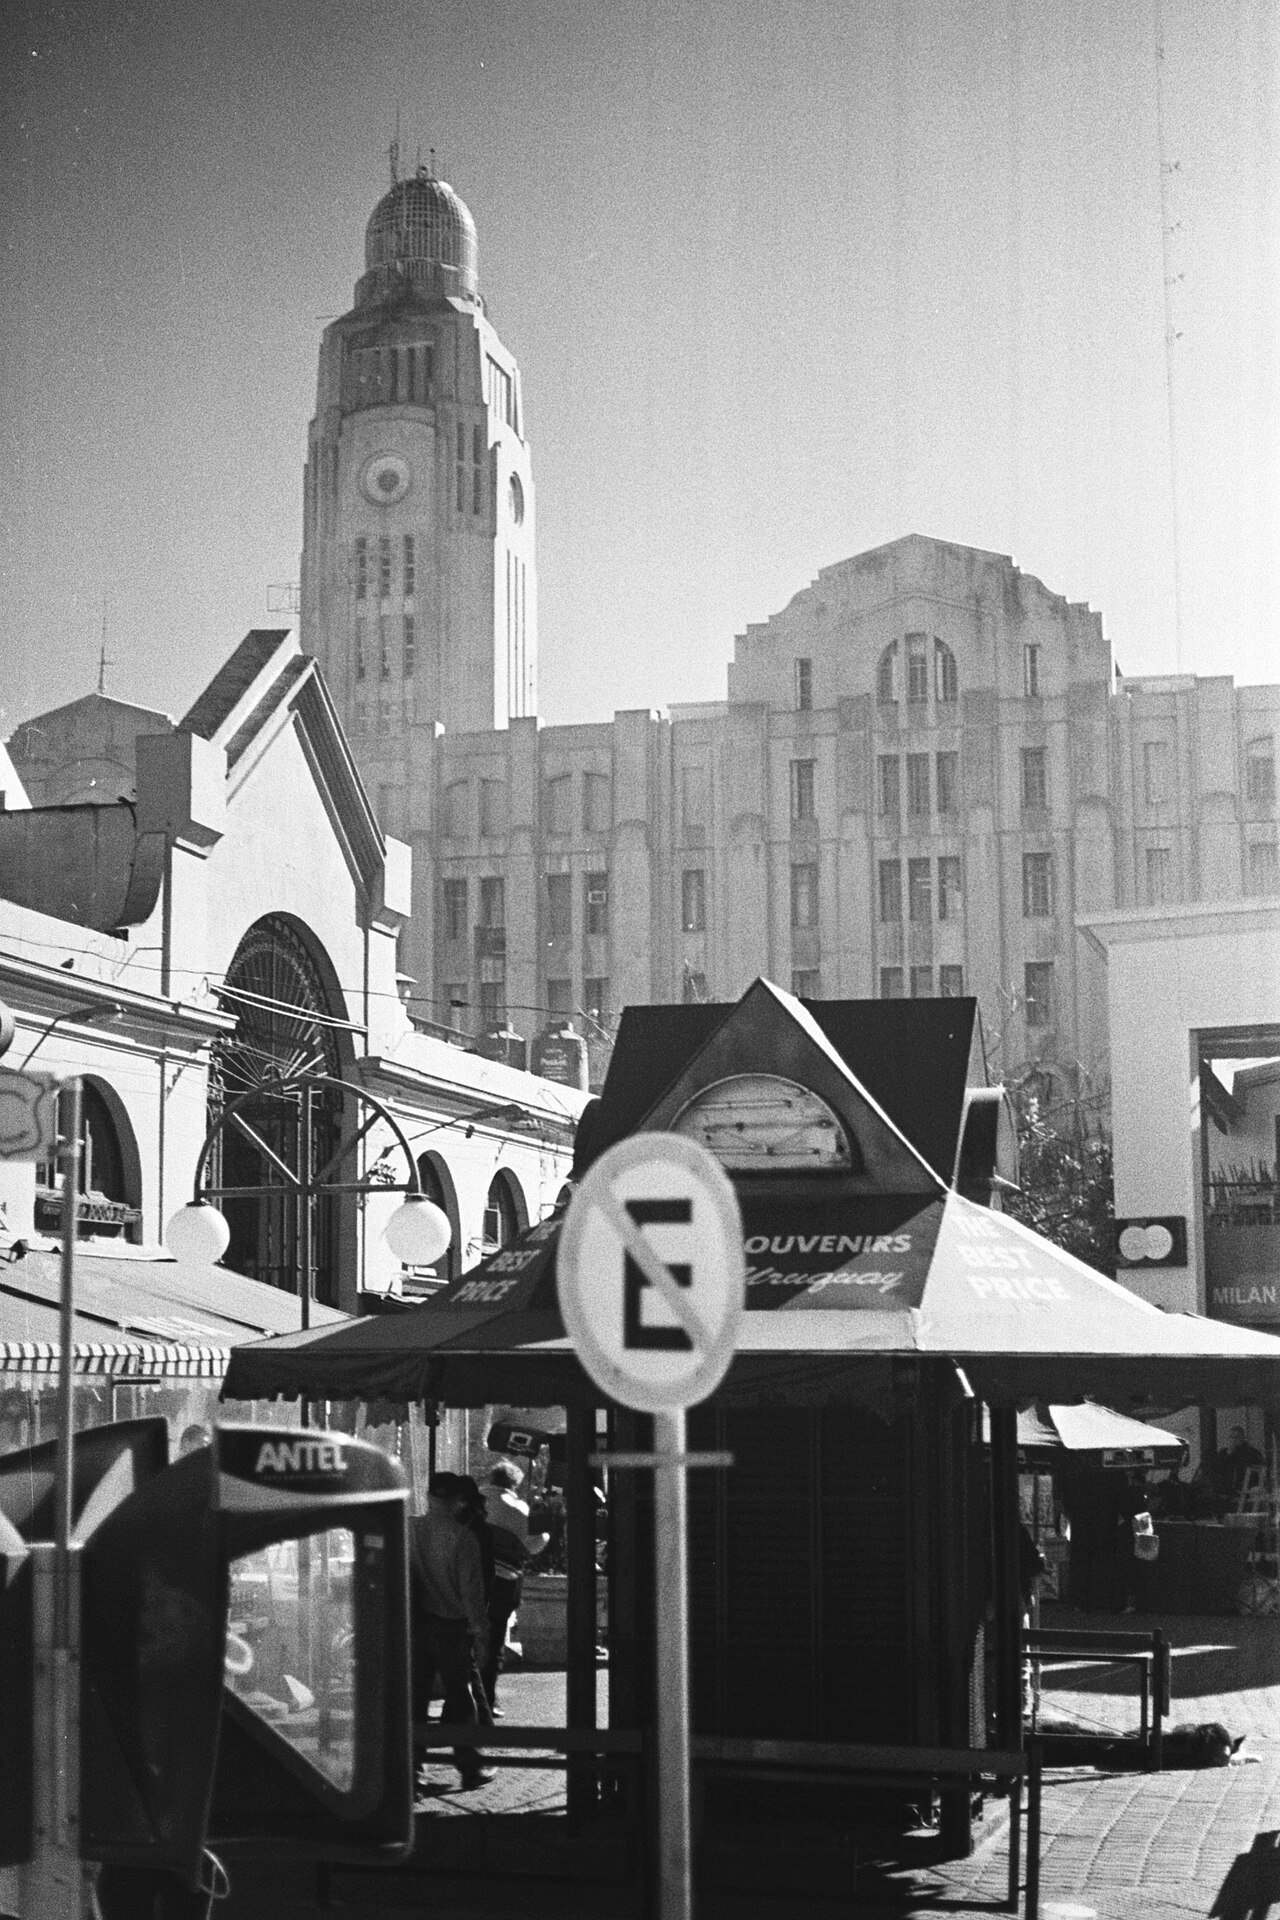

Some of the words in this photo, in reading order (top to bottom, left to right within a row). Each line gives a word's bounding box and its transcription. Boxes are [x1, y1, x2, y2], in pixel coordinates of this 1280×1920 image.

[949, 1214, 1002, 1239] THE
[744, 1234, 912, 1254] OUVENIRS
[487, 1249, 541, 1272] BEST
[956, 1245, 1033, 1269] BEST
[624, 1199, 694, 1351] E
[450, 1280, 518, 1302] PRICE
[966, 1276, 1071, 1300] PRICE
[255, 1442, 348, 1473] ANTEL
